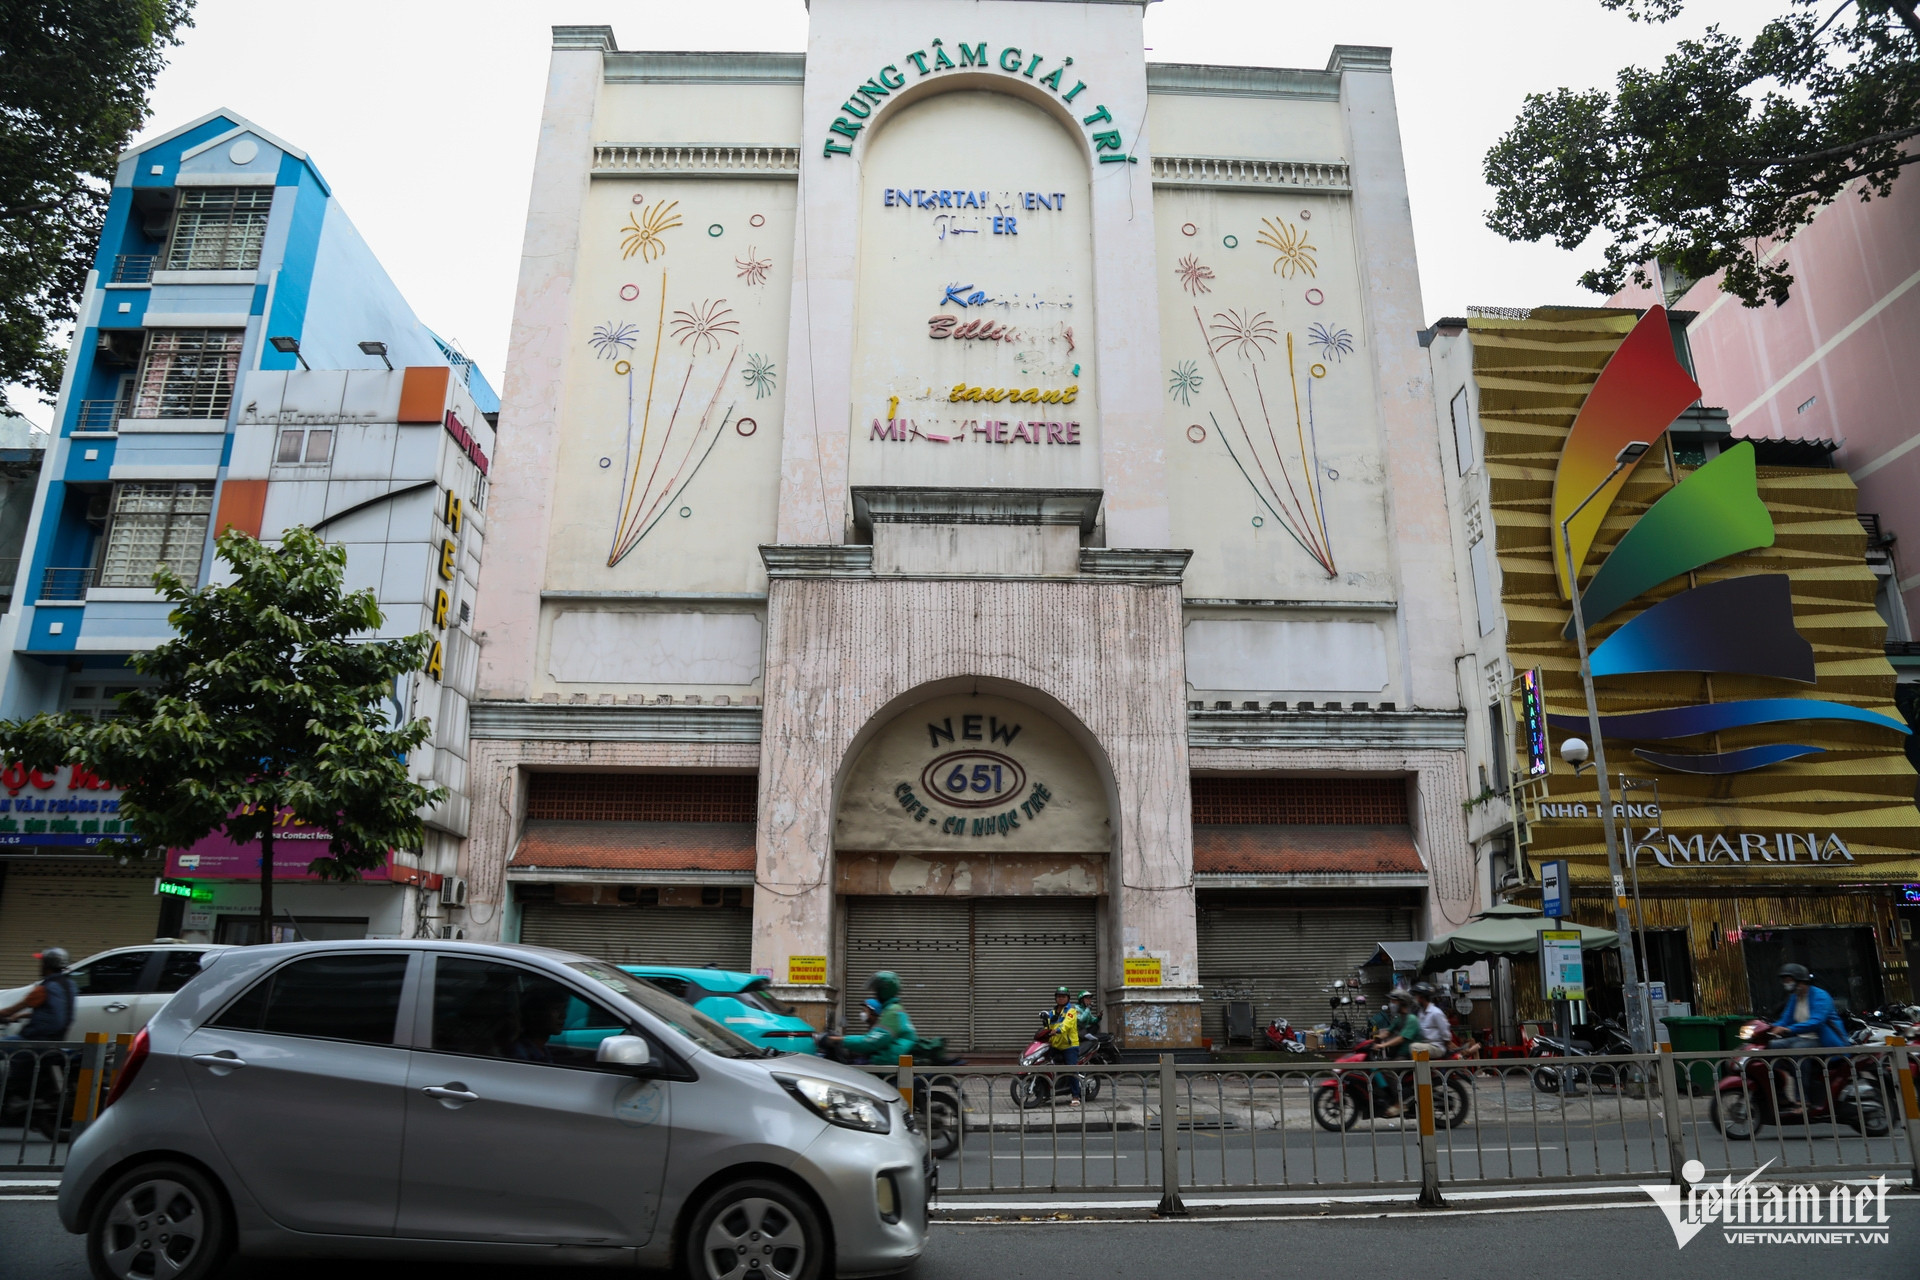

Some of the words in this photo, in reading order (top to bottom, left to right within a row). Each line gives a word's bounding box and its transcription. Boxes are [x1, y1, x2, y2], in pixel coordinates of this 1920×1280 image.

[823, 64, 906, 158] TRUNG
[906, 37, 989, 75] TÂM
[1083, 104, 1138, 164] TRÍ
[425, 489, 463, 682] HERA
[927, 714, 1022, 748] NEW
[946, 764, 1003, 793] 651
[1541, 801, 1588, 818] NHÀ
[282, 831, 310, 840] Contact
